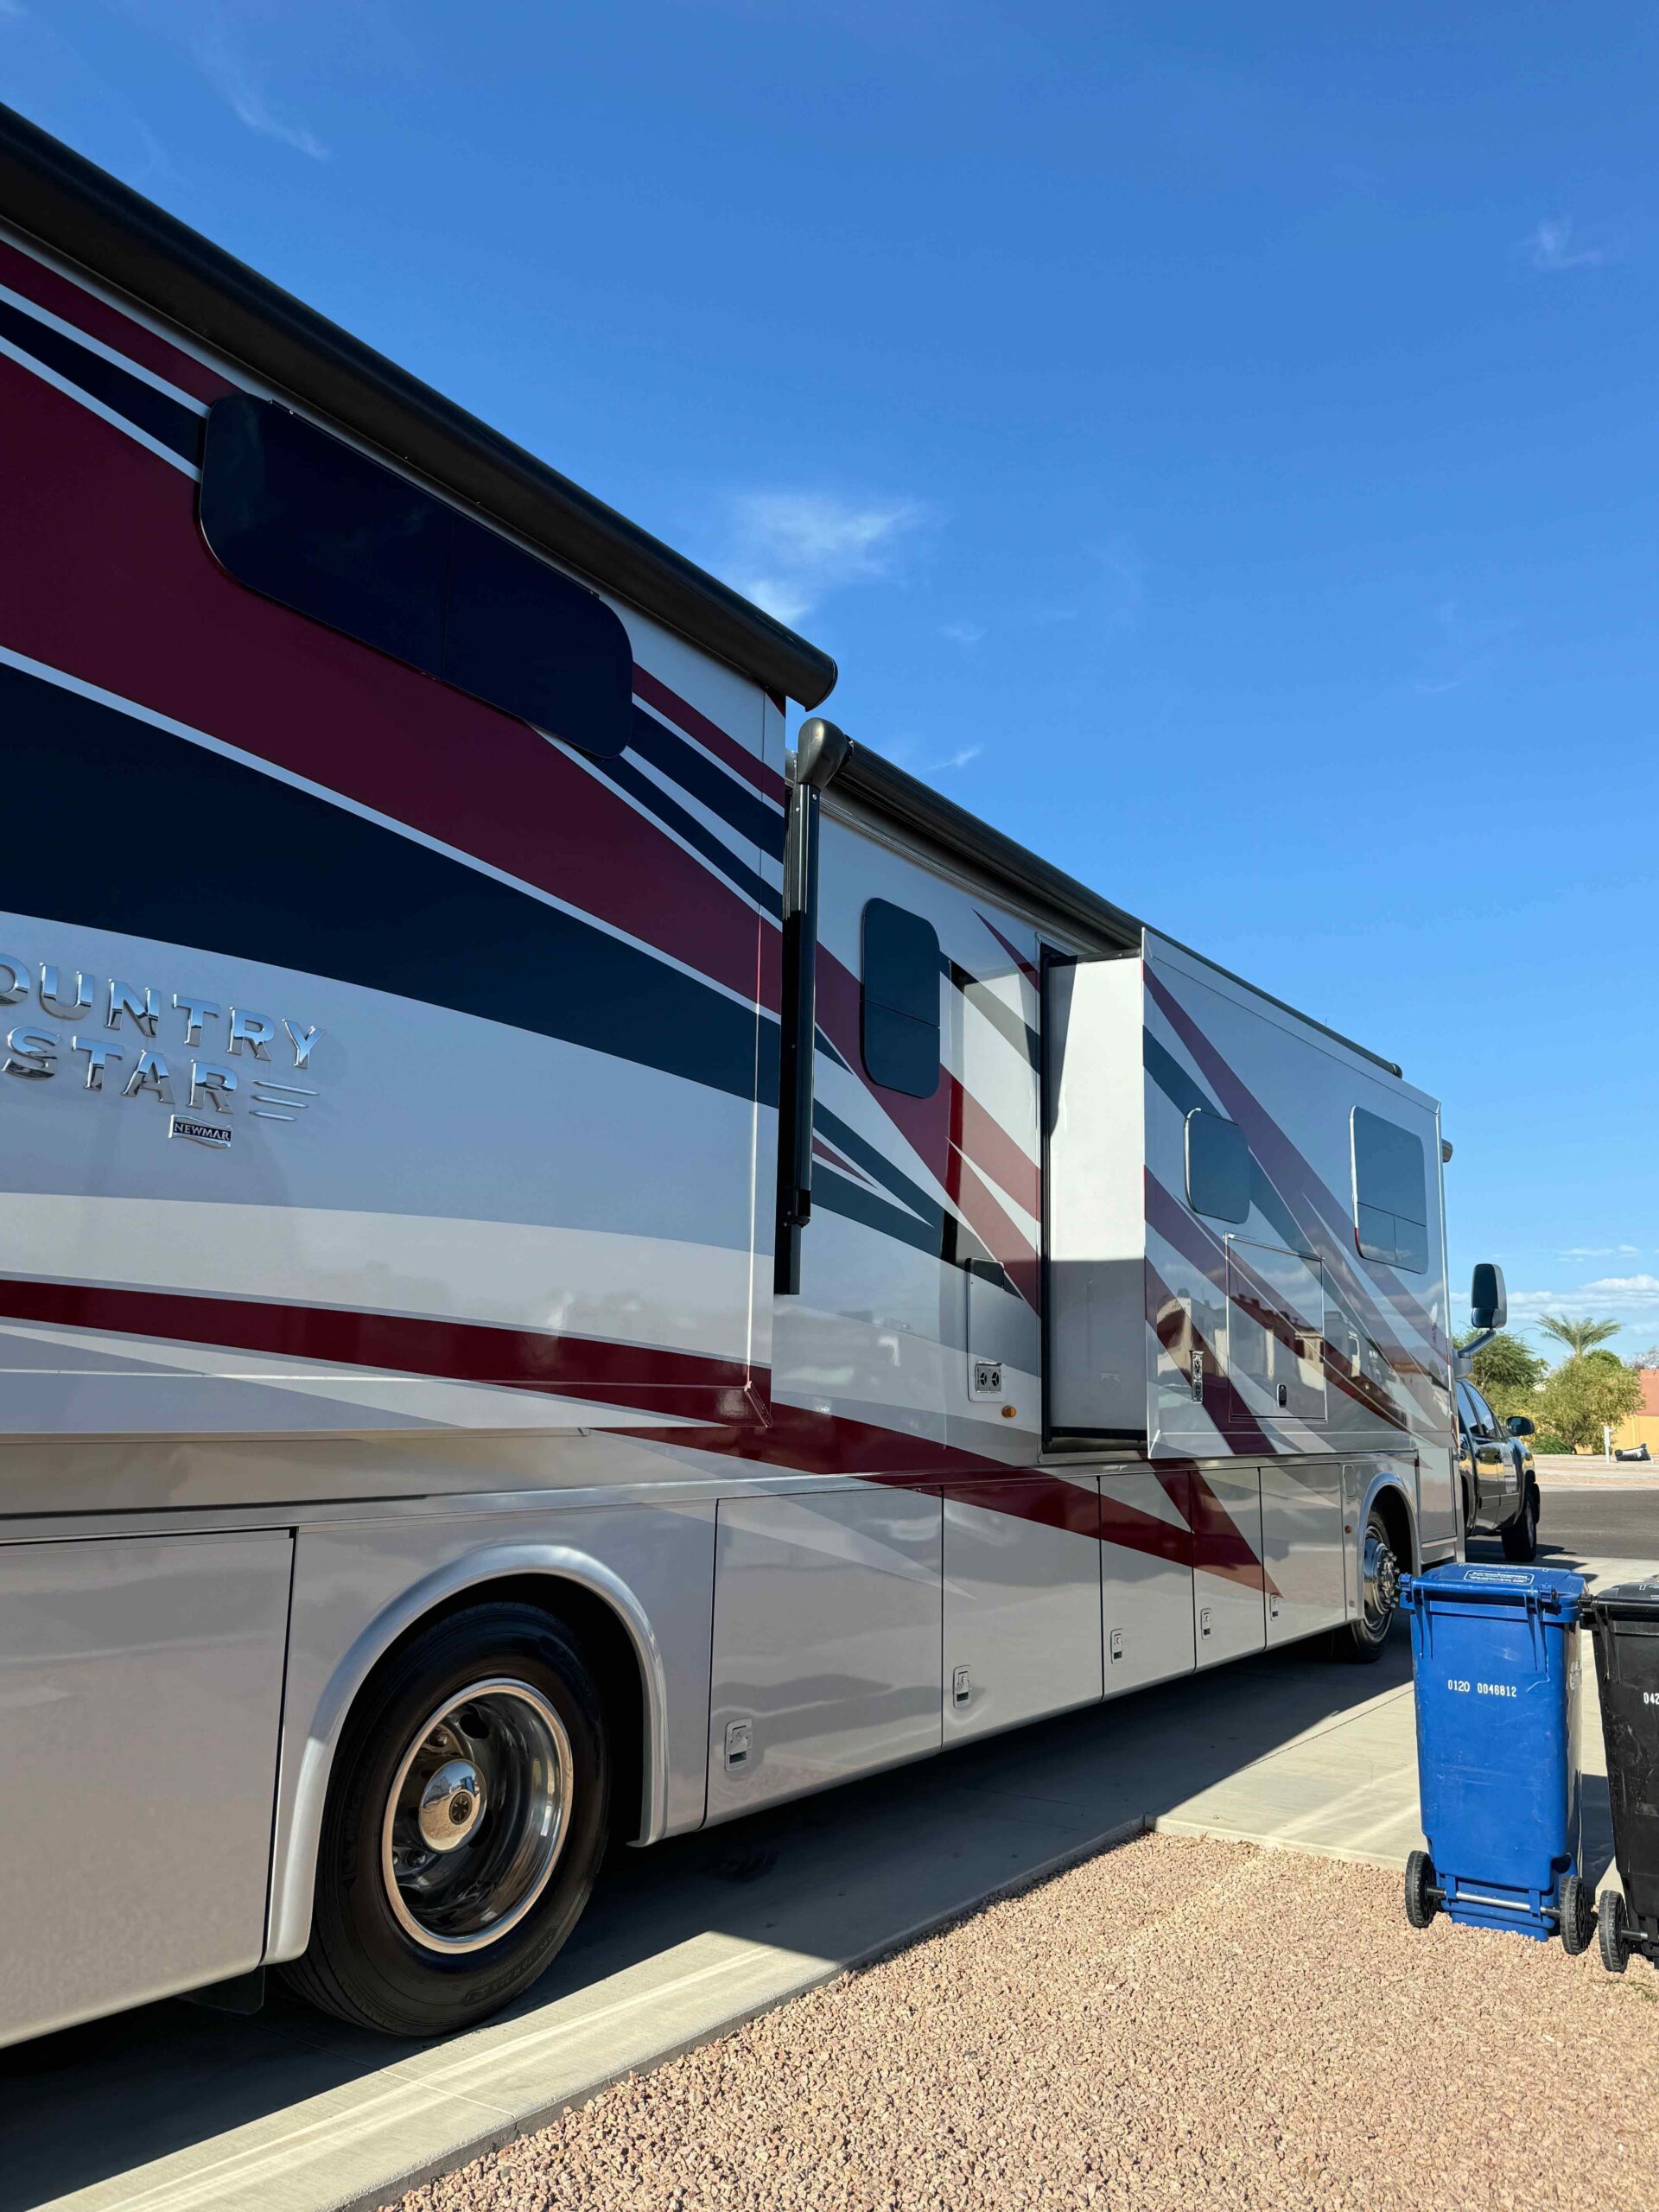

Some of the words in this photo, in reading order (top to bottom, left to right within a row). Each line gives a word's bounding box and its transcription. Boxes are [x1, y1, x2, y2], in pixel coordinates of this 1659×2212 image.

[1, 1026, 239, 1114] STAR
[174, 1122, 230, 1141] NEWMAR
[1447, 1679, 1471, 1693] 0120
